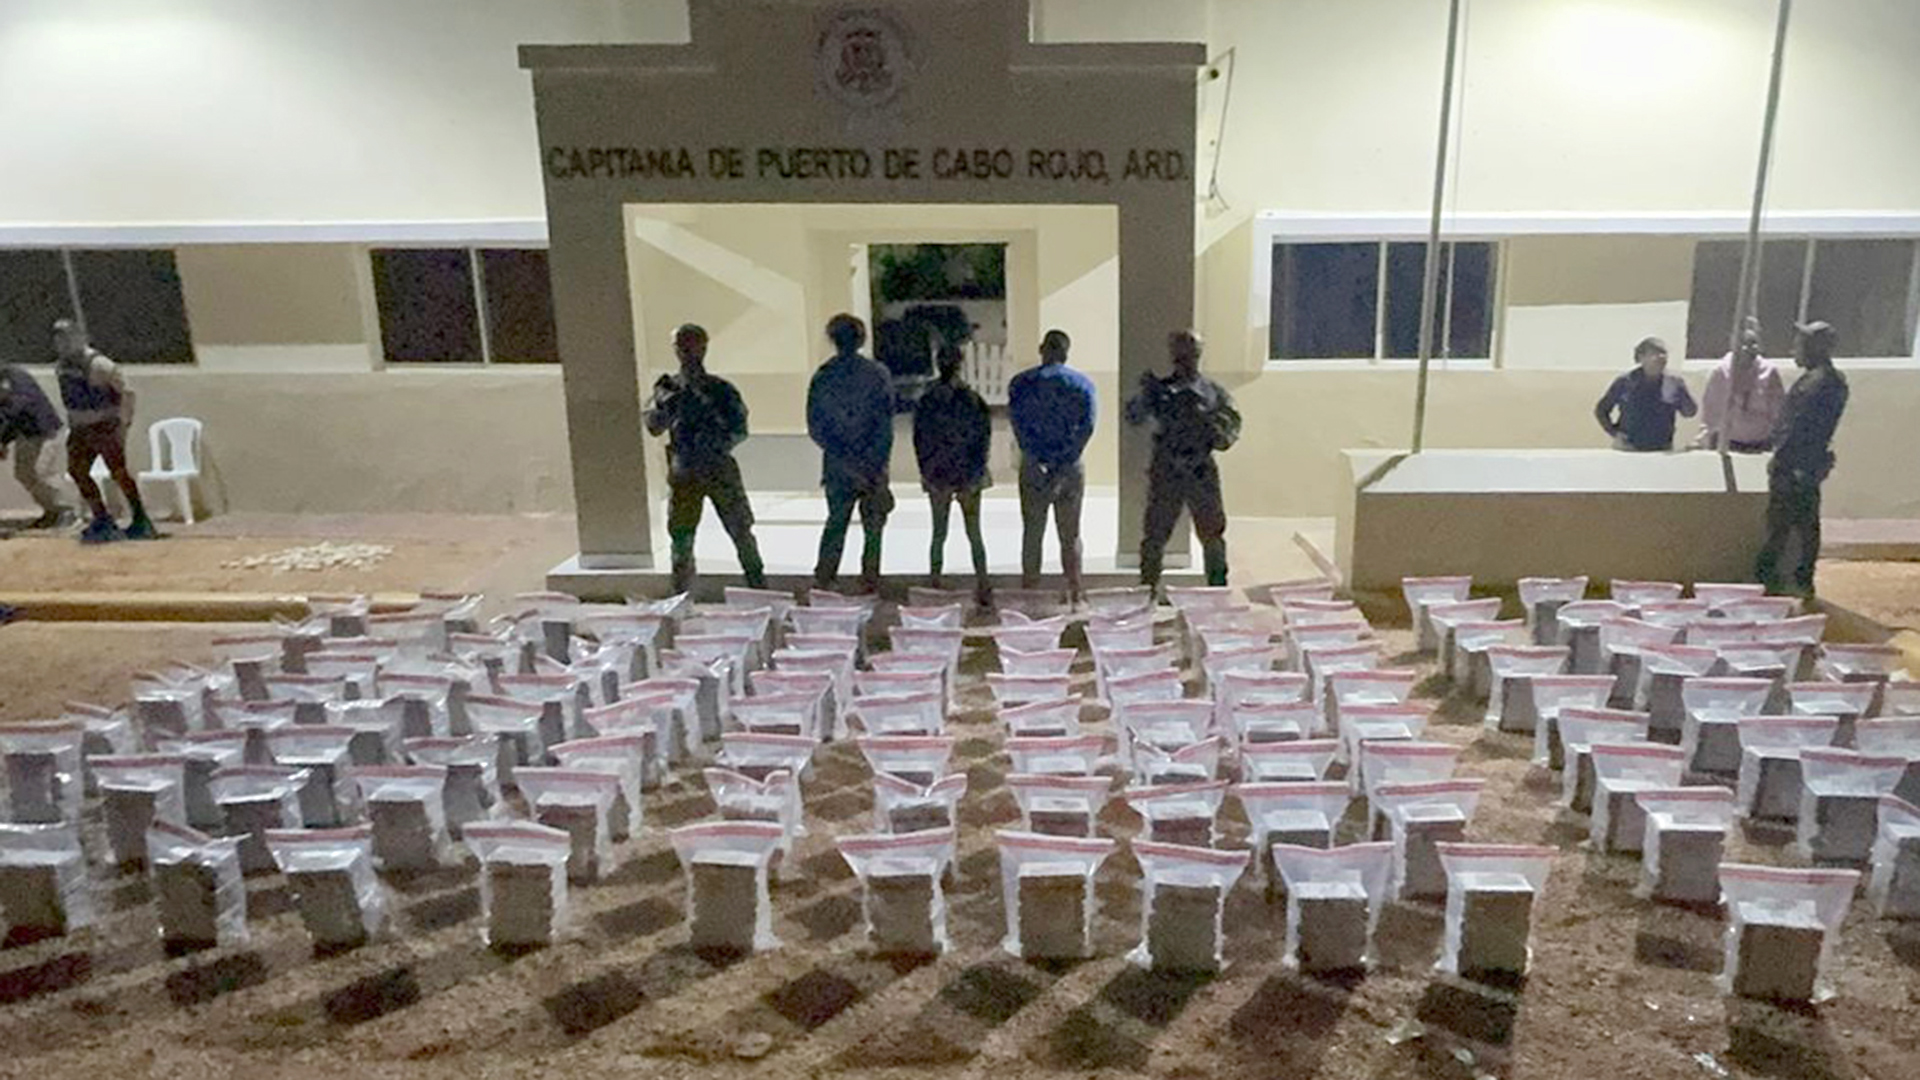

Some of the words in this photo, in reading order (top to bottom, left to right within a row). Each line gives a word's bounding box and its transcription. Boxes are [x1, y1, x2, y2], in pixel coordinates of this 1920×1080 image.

[707, 148, 745, 179] DE
[757, 148, 870, 180] PUERTO
[883, 148, 920, 180] DE
[931, 147, 1015, 180] CABO
